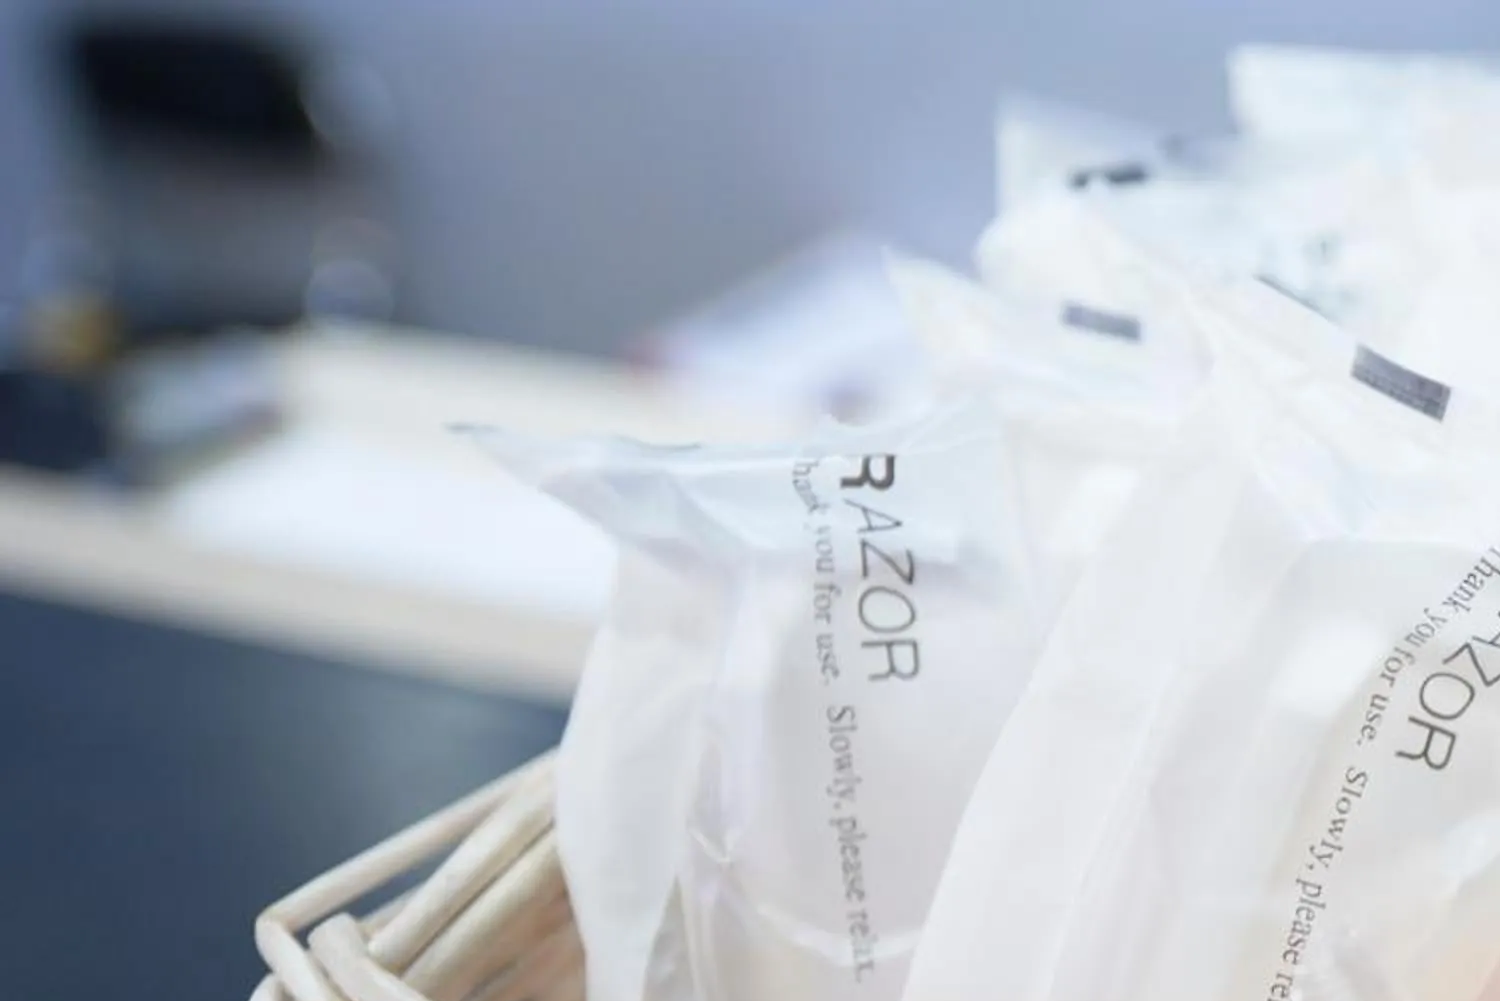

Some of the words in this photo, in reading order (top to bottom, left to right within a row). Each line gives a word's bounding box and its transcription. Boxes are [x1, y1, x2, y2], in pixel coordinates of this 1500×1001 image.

[839, 453, 921, 683] RAZOR
[1403, 606, 1450, 650] you
[1378, 646, 1417, 689] for
[813, 580, 843, 625] for
[828, 814, 868, 902] please
[1355, 693, 1391, 747] use.
[1282, 876, 1327, 967] please
